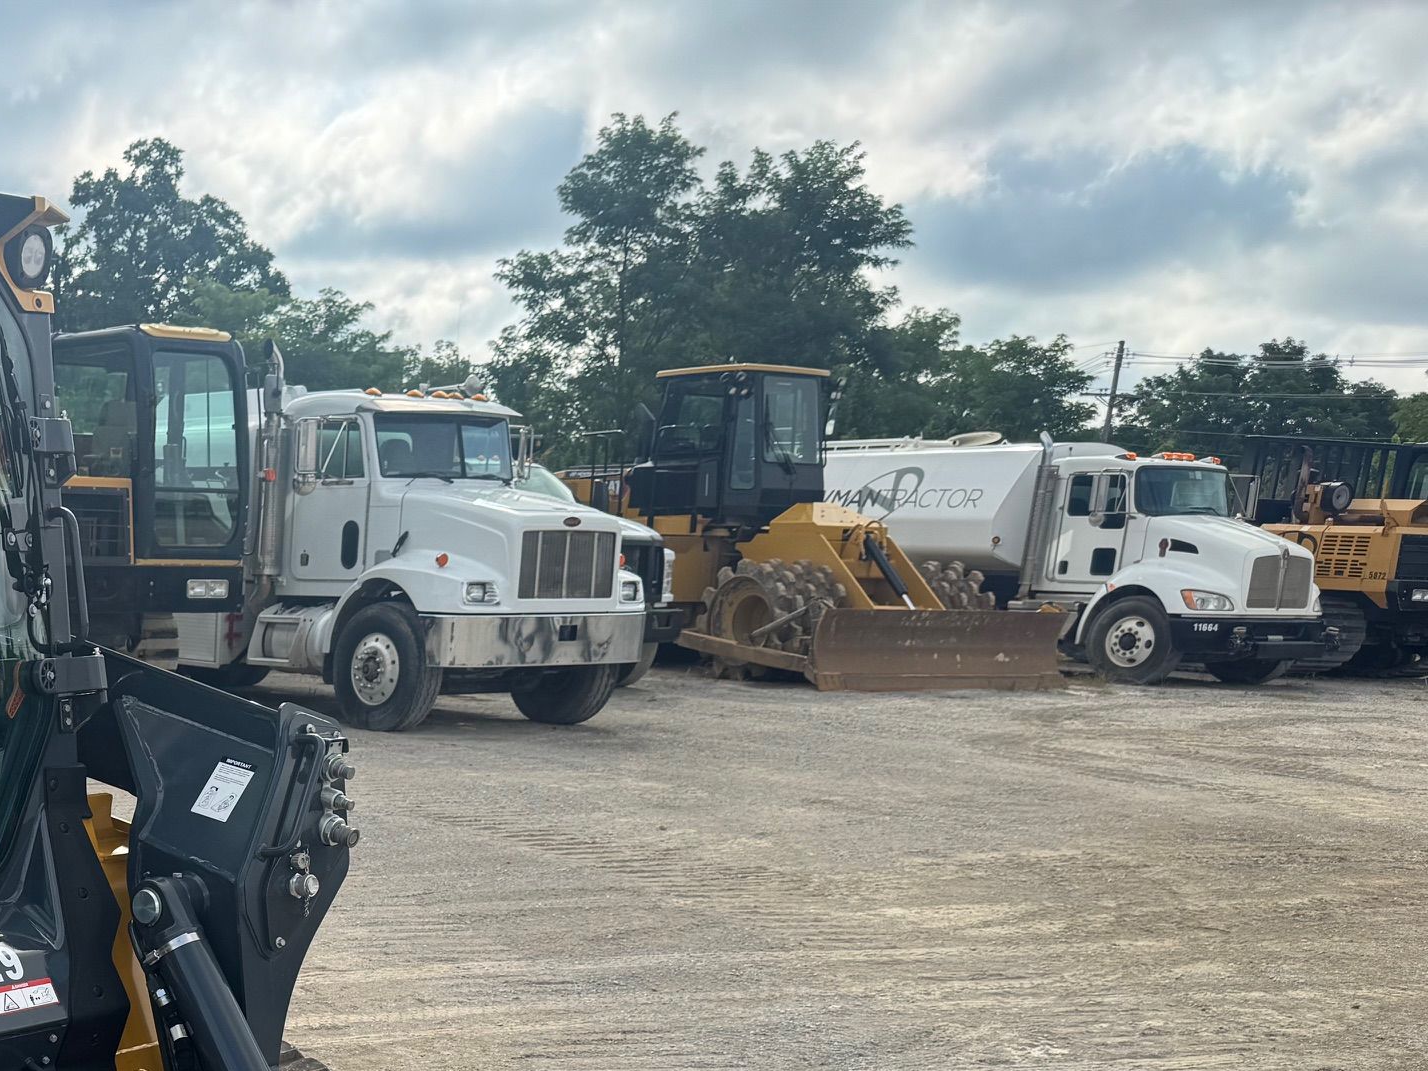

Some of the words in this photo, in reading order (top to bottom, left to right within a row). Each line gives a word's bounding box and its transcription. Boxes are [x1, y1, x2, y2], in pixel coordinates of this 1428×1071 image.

[608, 480, 620, 495] AT
[1193, 623, 1219, 632] 11664
[225, 758, 253, 770] IMPORTANT
